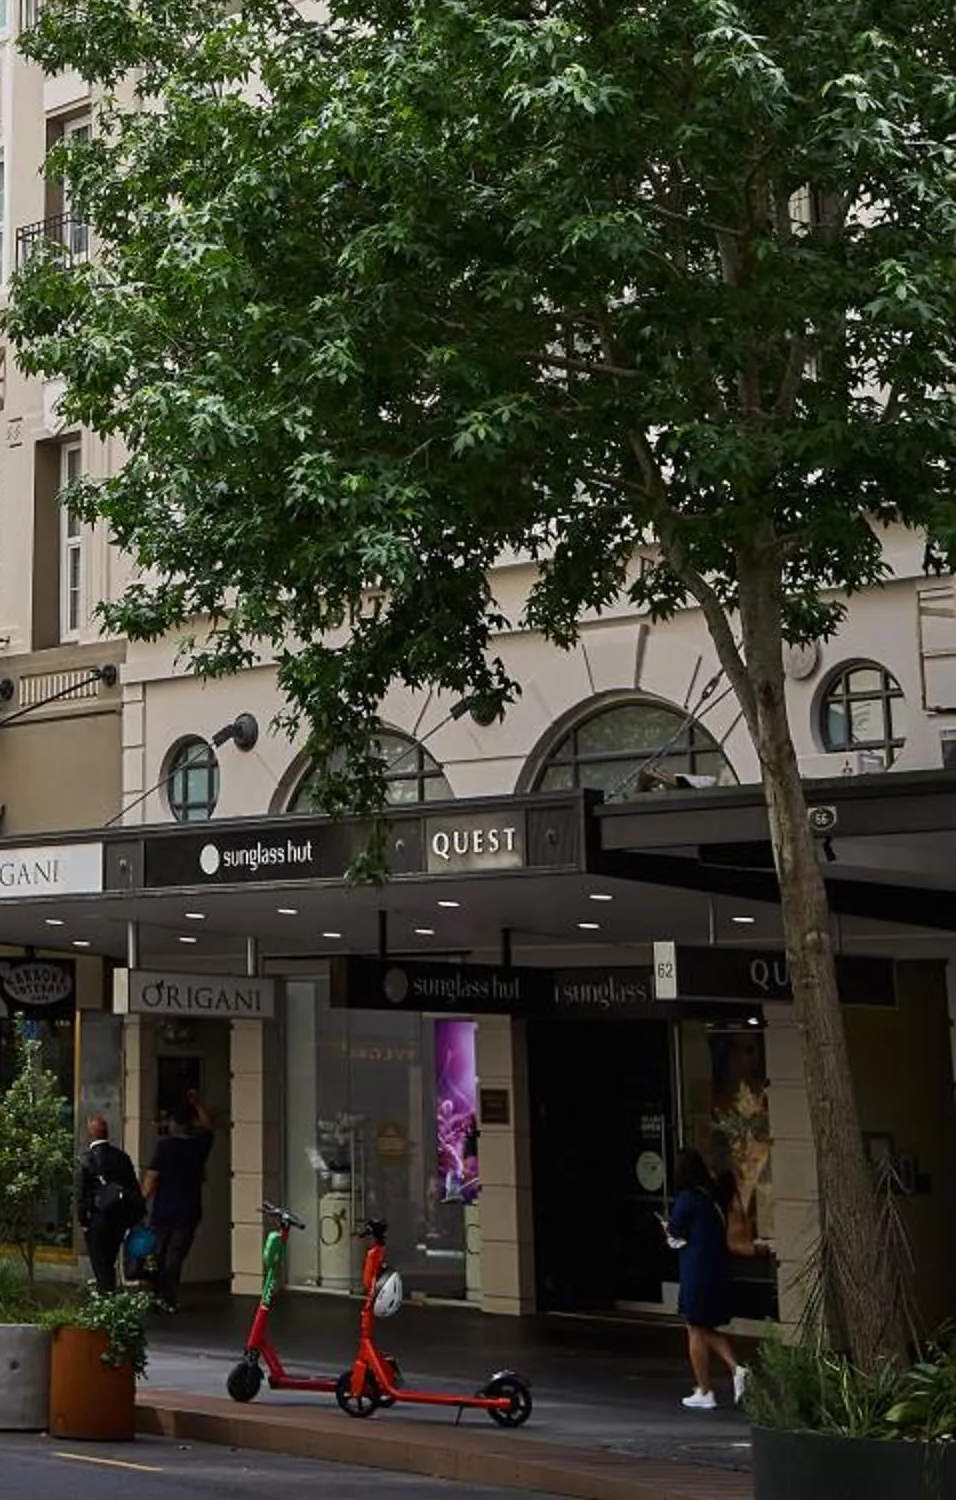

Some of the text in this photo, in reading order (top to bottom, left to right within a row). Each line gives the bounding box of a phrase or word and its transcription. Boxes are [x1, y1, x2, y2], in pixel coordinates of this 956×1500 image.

[223, 839, 313, 871] sunglass hut
[432, 827, 516, 860] QUEST
[413, 971, 521, 1004] sunglass hut
[658, 963, 673, 979] 62
[563, 976, 647, 1011] sunglass
